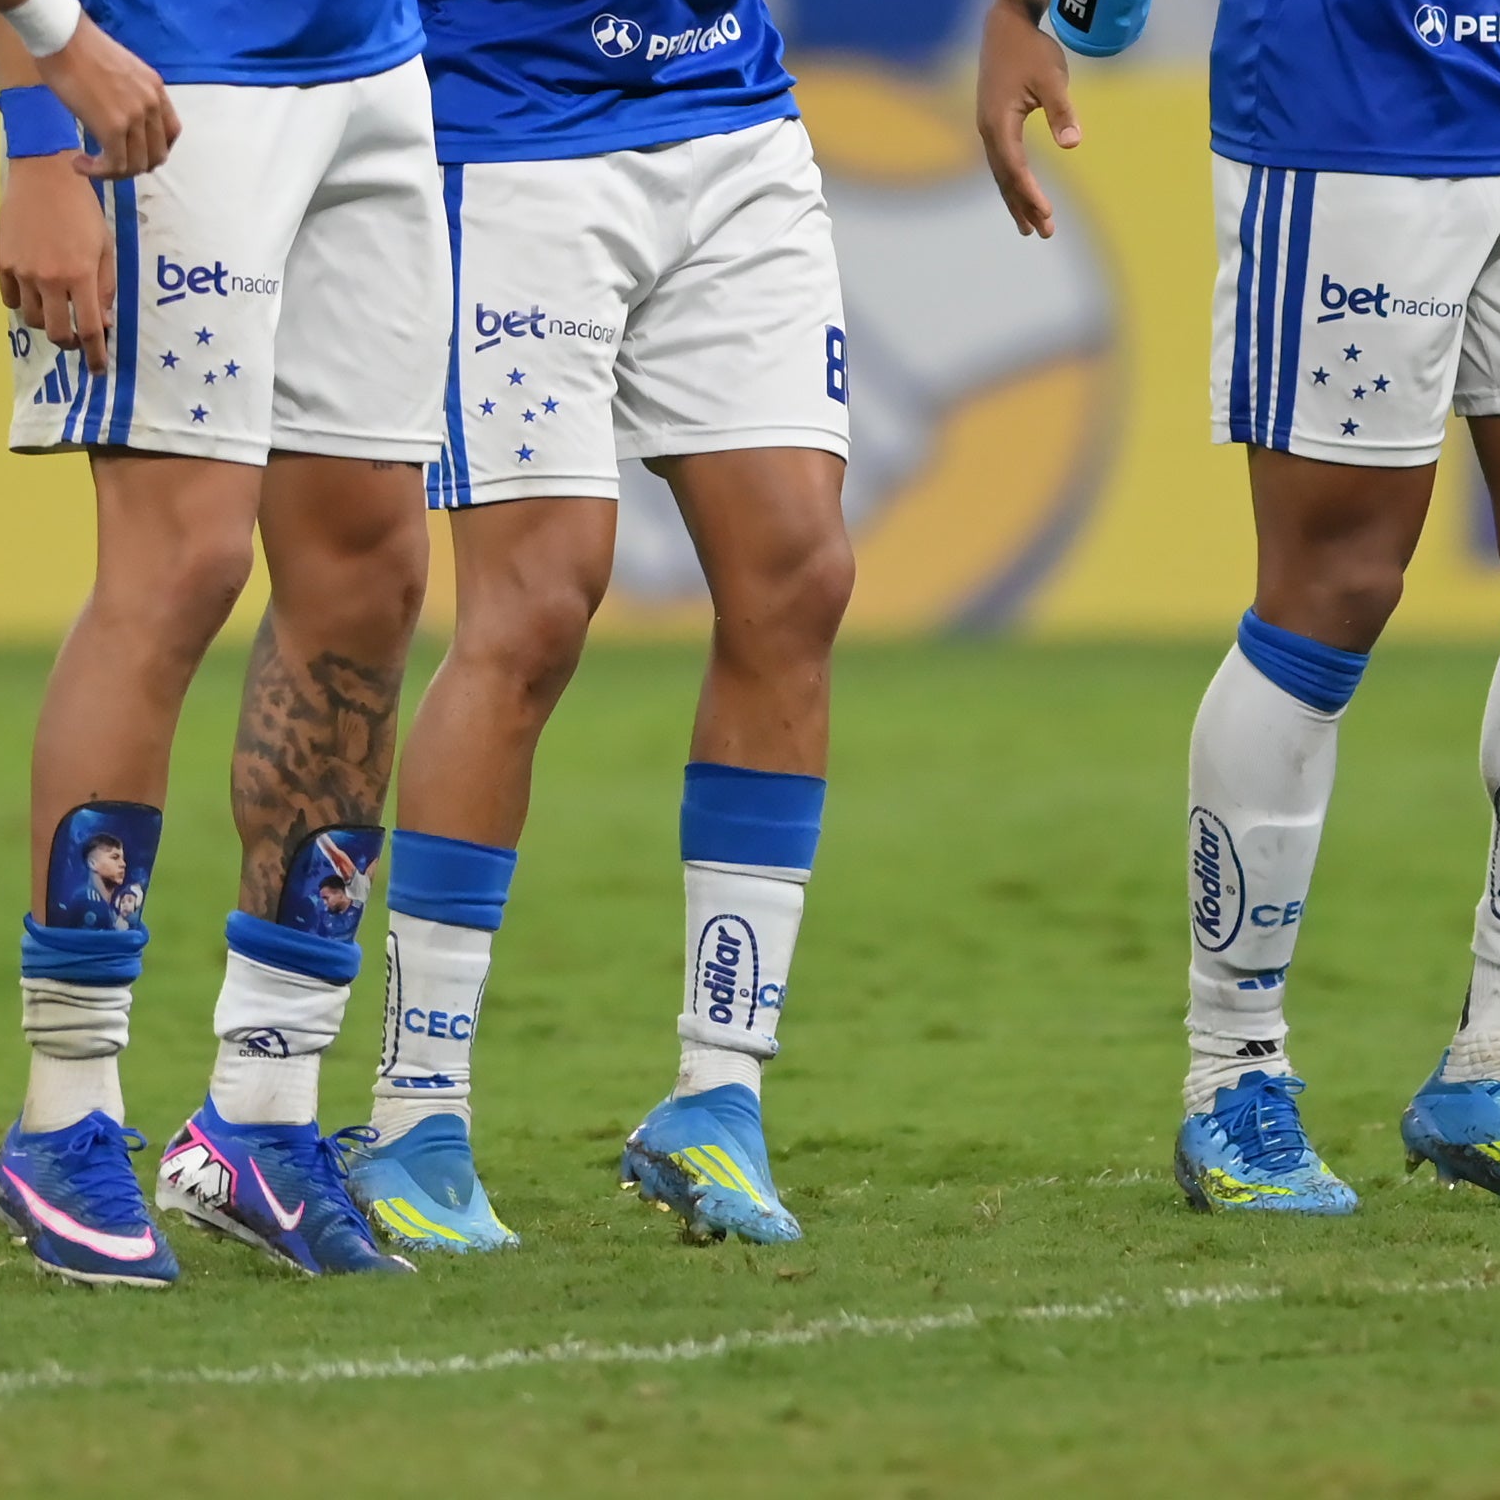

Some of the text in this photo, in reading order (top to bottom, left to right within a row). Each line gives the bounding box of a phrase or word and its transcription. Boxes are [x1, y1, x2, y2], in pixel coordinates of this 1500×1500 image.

[825, 323, 849, 410] 8
[1193, 817, 1221, 940] Kodilar
[1250, 900, 1307, 928] CE
[404, 1007, 472, 1041] CEC
